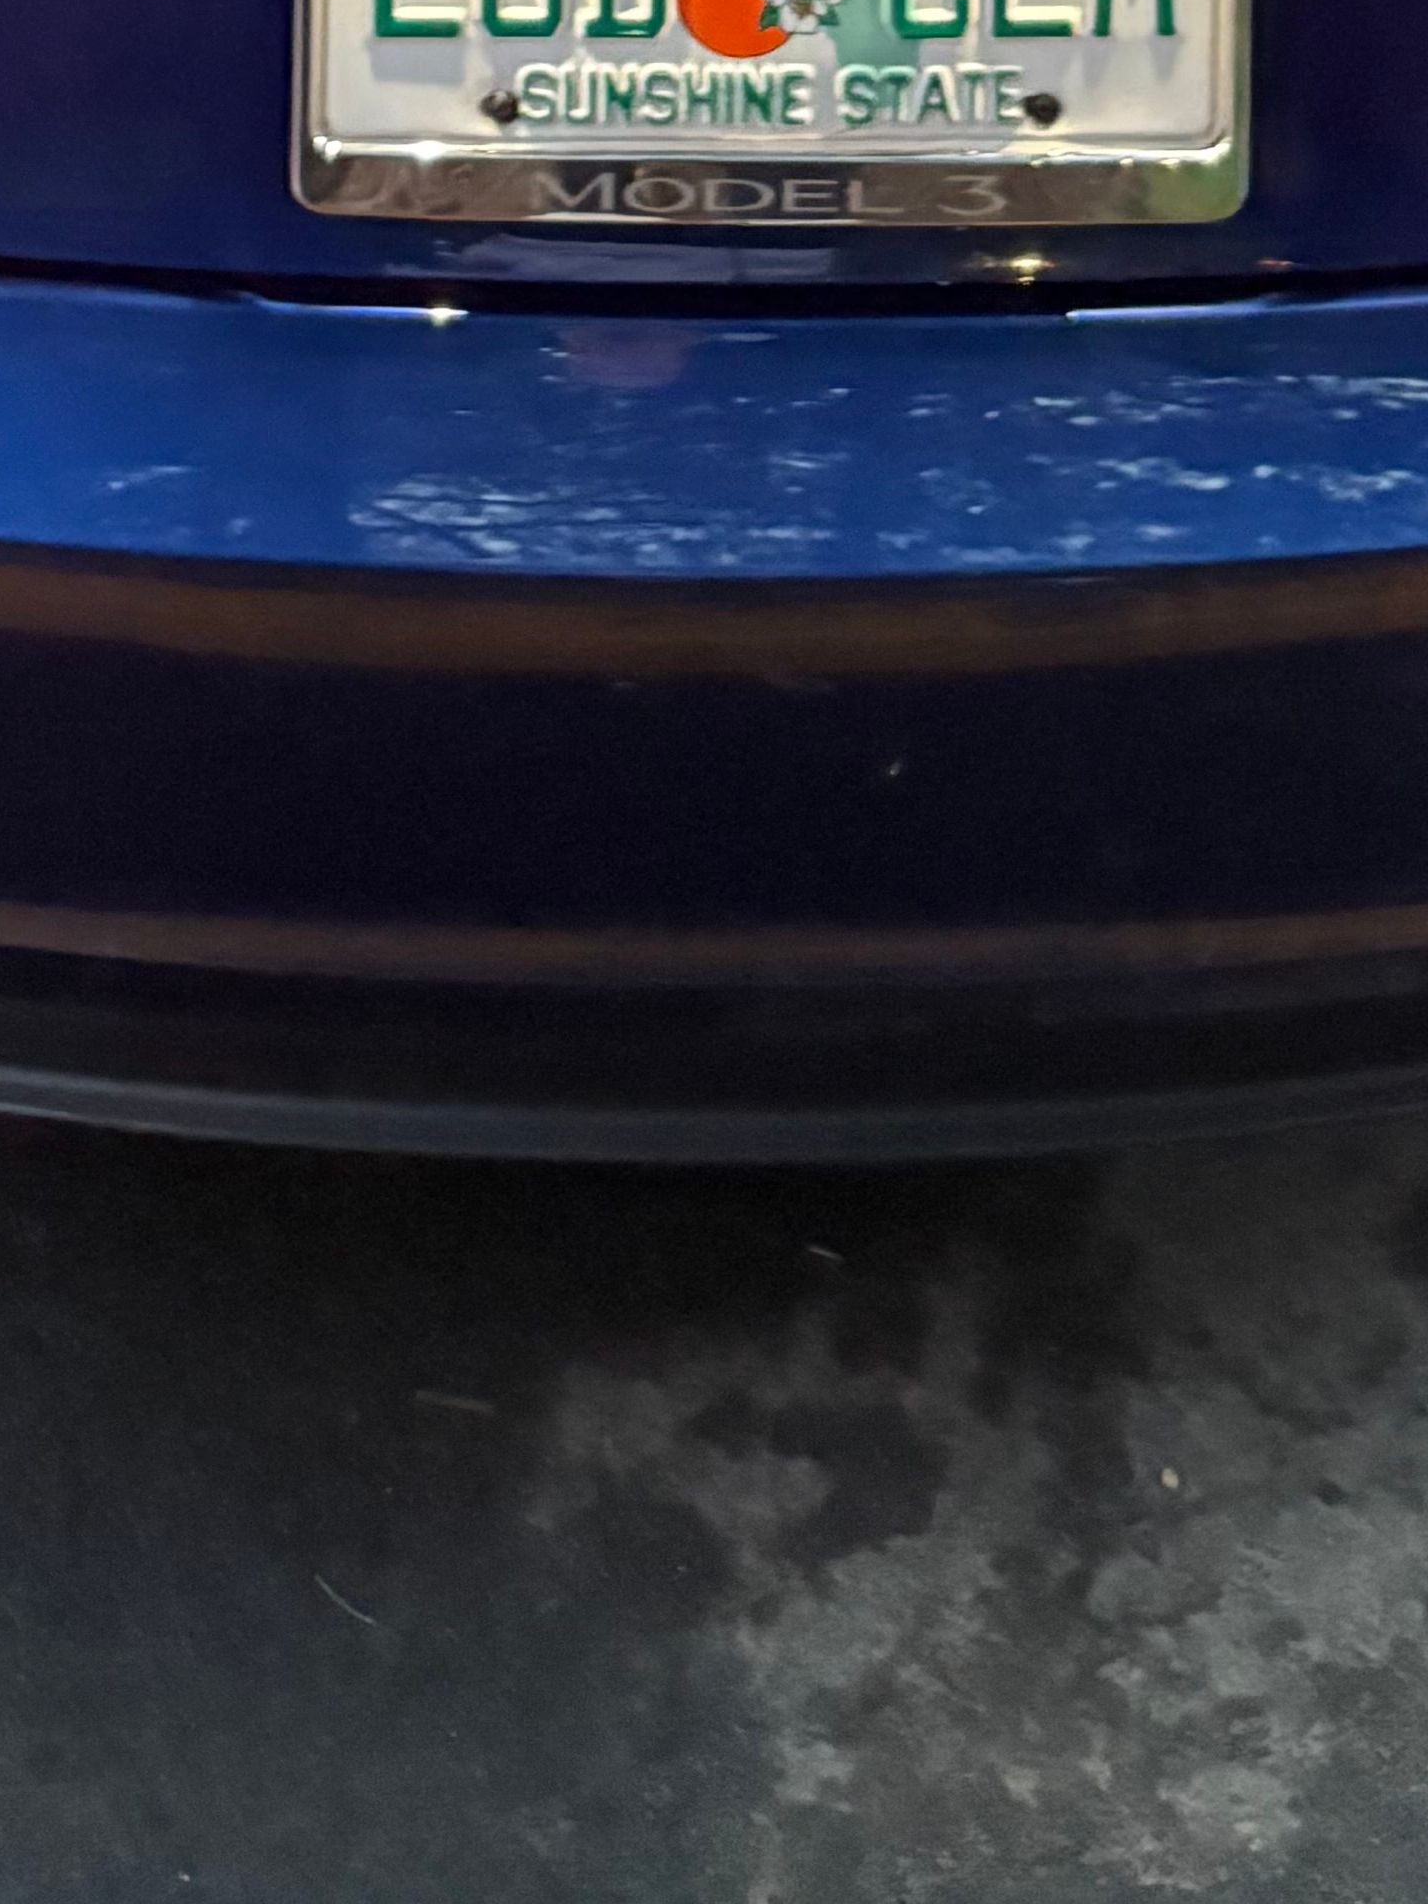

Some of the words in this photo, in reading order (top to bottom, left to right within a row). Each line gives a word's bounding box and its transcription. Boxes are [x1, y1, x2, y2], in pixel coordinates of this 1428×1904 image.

[515, 61, 817, 125] SUNSHINE
[835, 62, 1026, 125] STATE
[529, 170, 906, 215] MODEL
[935, 173, 1010, 216] 3
